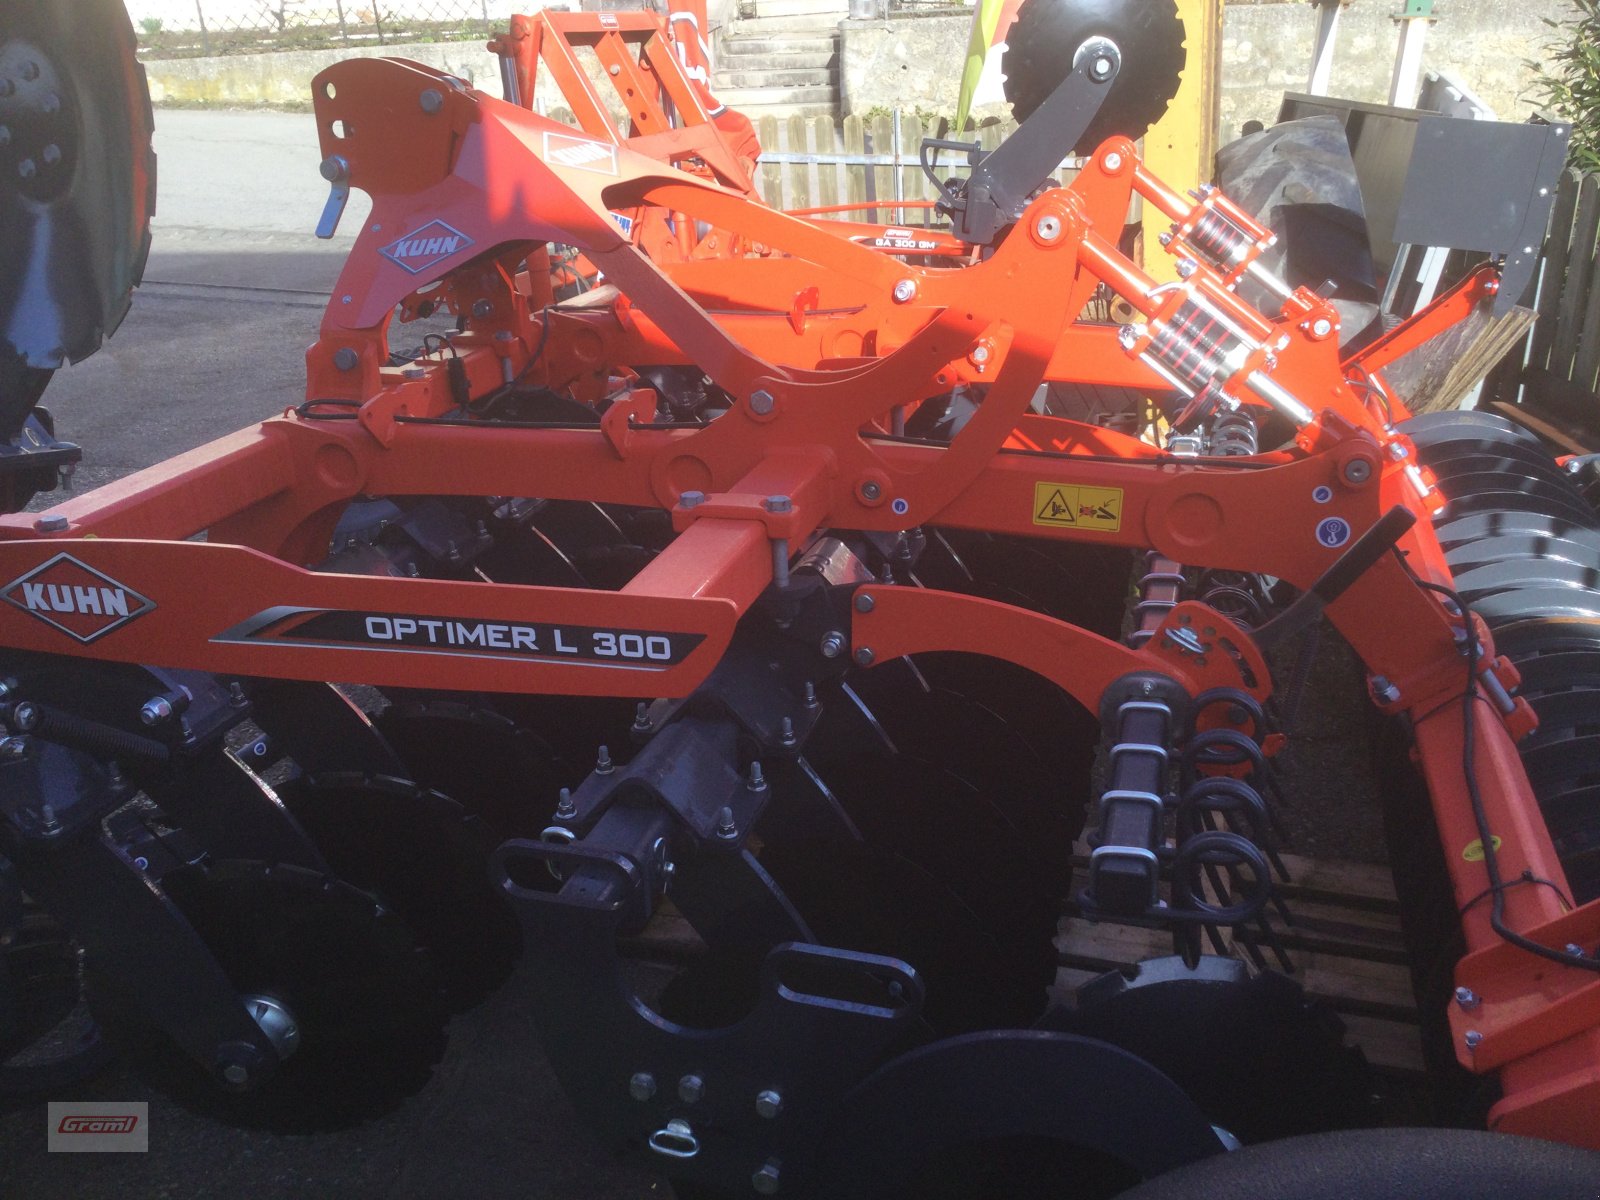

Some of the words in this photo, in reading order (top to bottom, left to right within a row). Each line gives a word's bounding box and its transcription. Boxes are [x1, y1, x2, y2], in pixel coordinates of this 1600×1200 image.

[393, 235, 460, 258] KUHN
[876, 238, 891, 247] GA
[895, 240, 915, 248] 300
[22, 582, 130, 618] KUHN
[365, 616, 540, 650] OPTIMER
[553, 629, 578, 654] L
[592, 632, 671, 660] 300
